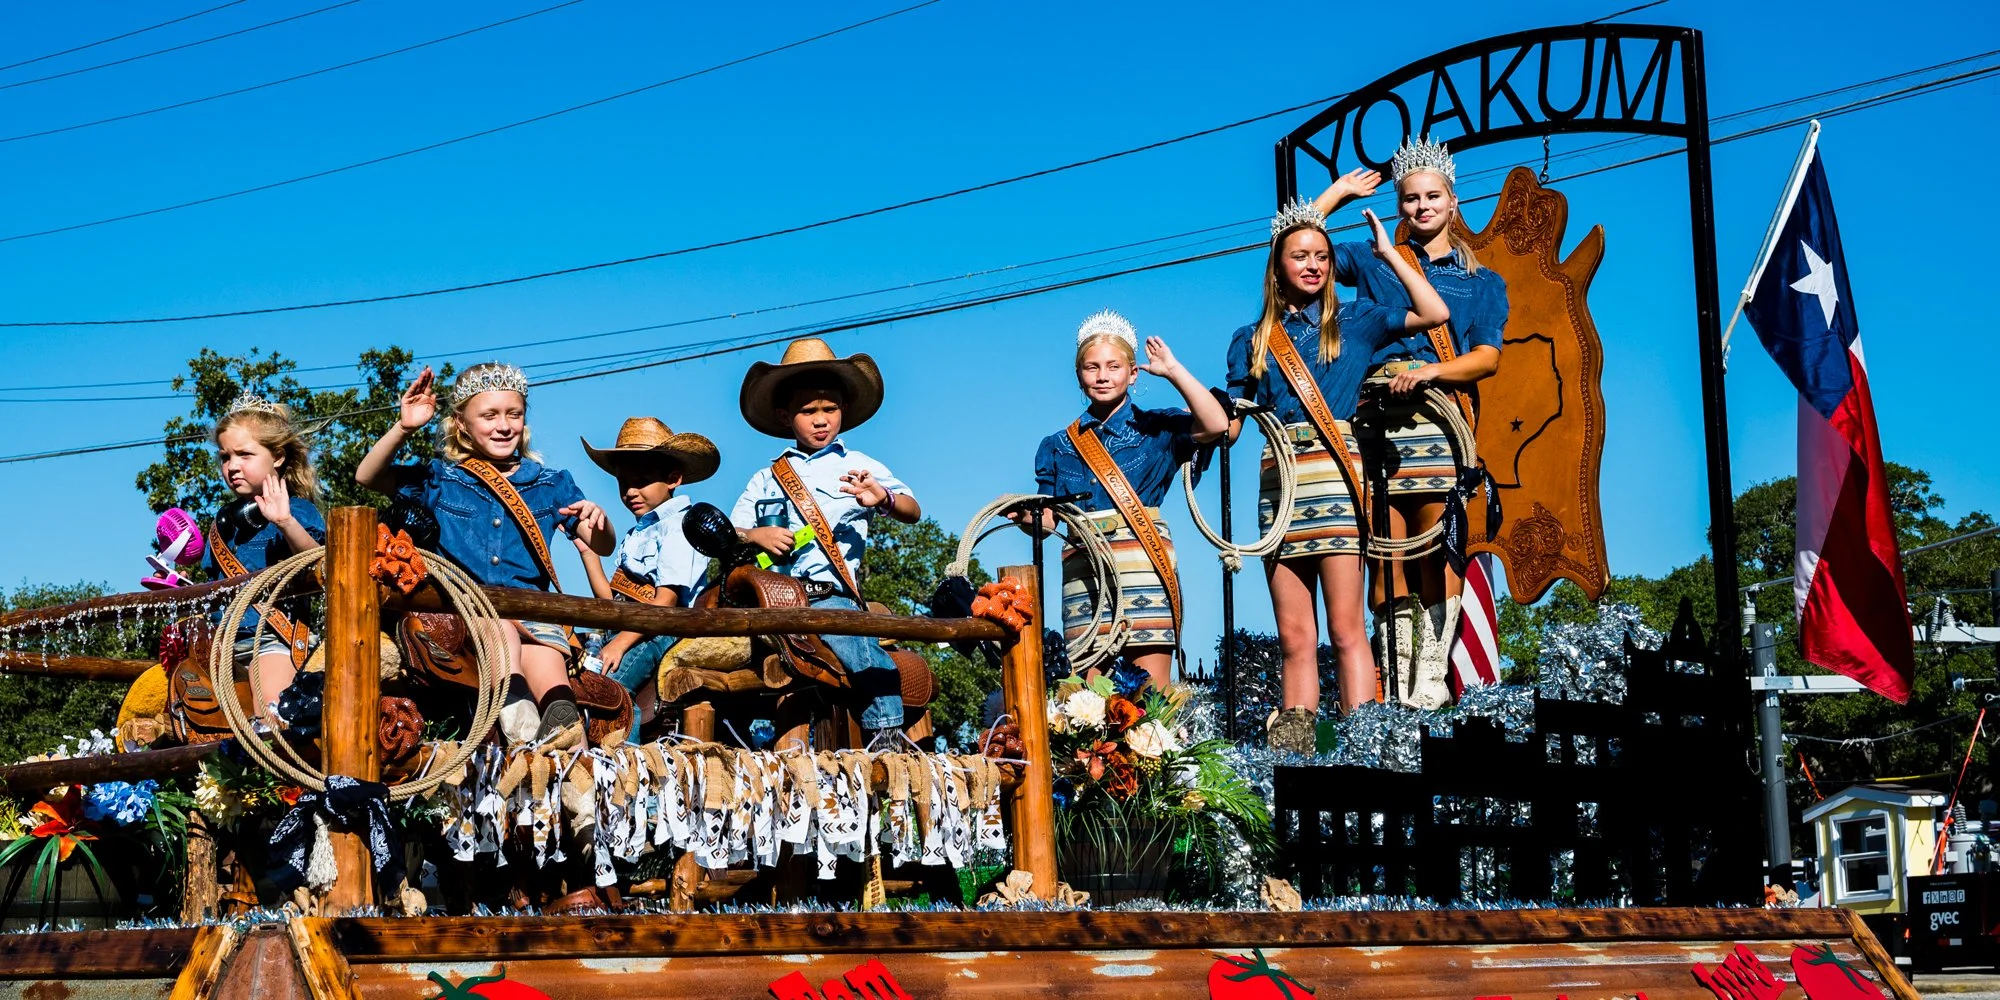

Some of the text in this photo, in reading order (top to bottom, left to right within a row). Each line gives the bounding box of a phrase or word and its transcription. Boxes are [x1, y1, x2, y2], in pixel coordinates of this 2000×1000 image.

[1297, 37, 1674, 184] YOAKUM
[1433, 326, 1449, 361] Yoaku
[1313, 402, 1340, 446] Yoakum
[490, 475, 514, 500] Miss
[511, 500, 545, 558] Yoakum
[780, 469, 844, 571] Little Prince 2024
[1128, 502, 1146, 527] Miss
[1143, 527, 1169, 575] Yoakum
[632, 583, 655, 600] Miste
[1930, 911, 1960, 931] gvec
